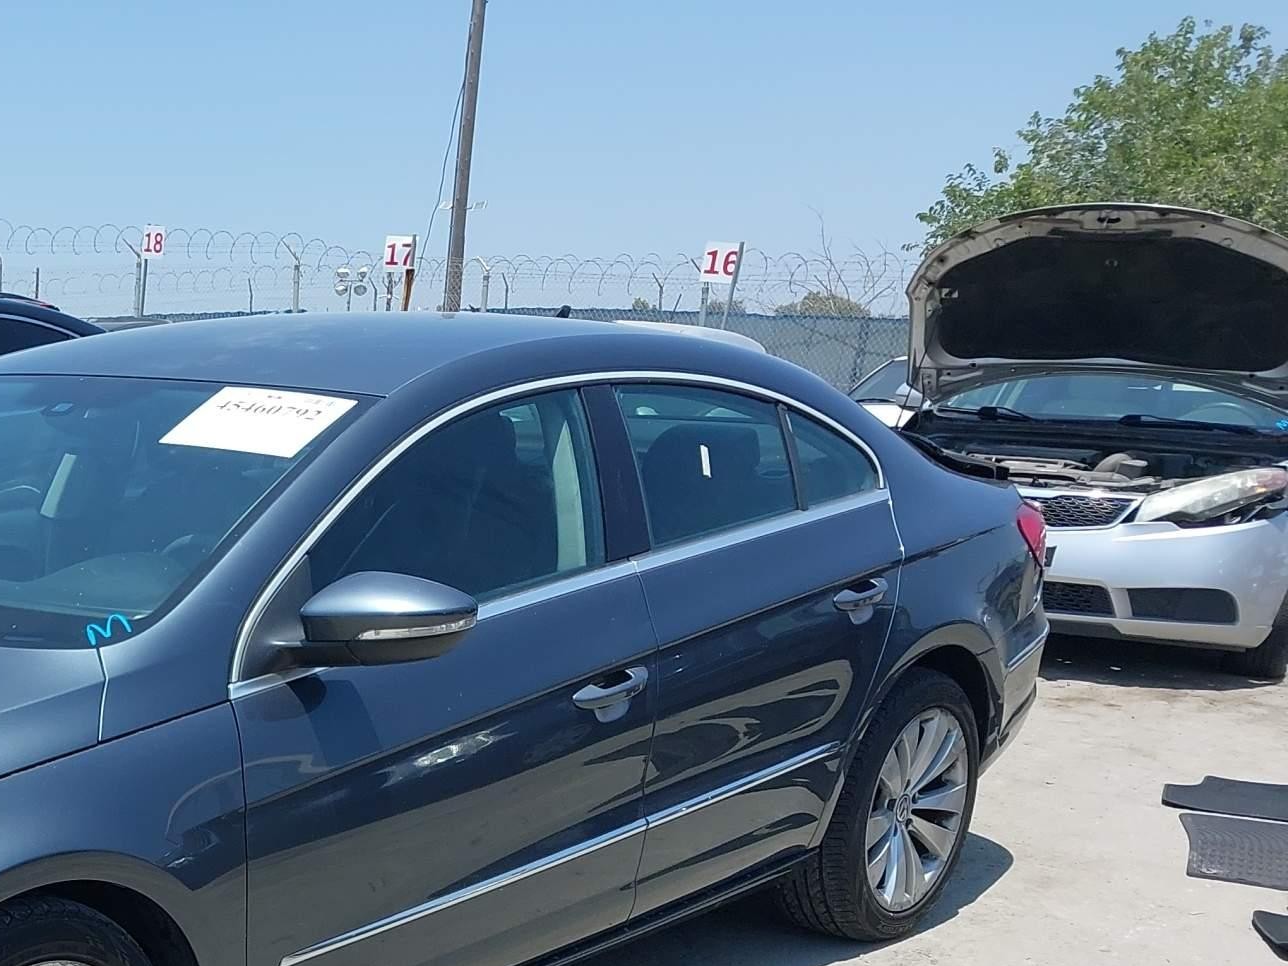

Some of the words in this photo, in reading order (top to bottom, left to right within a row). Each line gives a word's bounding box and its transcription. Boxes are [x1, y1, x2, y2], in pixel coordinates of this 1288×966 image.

[144, 231, 163, 253] 18
[385, 243, 415, 265] 17
[703, 249, 738, 276] 16
[216, 400, 323, 421] 45460792
